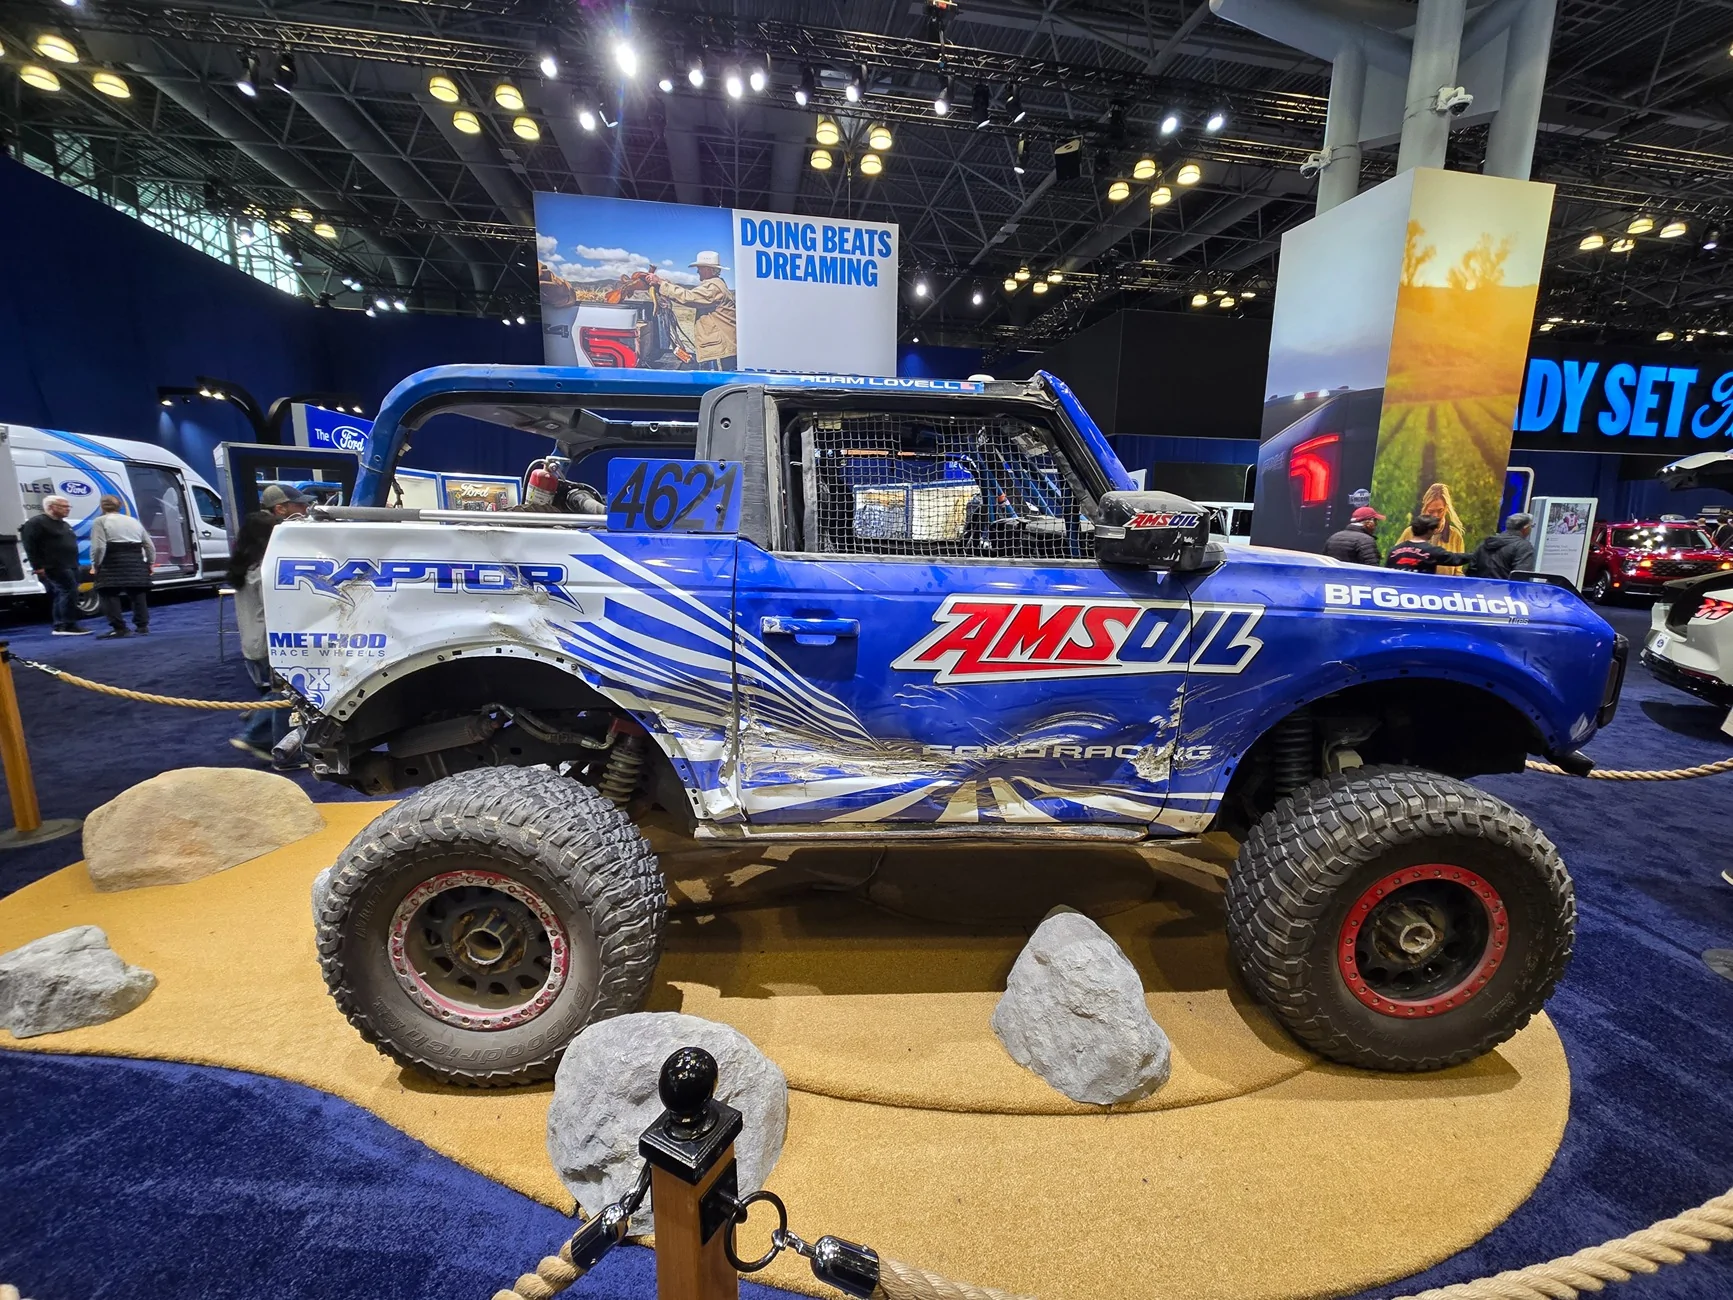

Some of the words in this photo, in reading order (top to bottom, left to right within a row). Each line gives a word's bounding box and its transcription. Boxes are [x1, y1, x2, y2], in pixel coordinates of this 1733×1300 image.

[740, 217, 817, 253] DOING
[822, 225, 892, 258] BEATS
[755, 250, 878, 287] DREAMING
[800, 374, 865, 385] ADAM
[868, 377, 959, 390] LOVELL
[1513, 358, 1600, 433] DY
[1597, 363, 1699, 438] SET
[314, 427, 330, 442] The
[340, 429, 365, 455] Ford
[65, 481, 89, 495] Ford
[460, 482, 490, 498] Ford
[609, 461, 738, 532] 4621
[1126, 512, 1201, 530] AMSOIL
[274, 557, 585, 614] RAPTOR
[1324, 583, 1530, 616] BFGoodrich
[1508, 616, 1530, 626] Tires
[269, 632, 388, 649] METHOD
[270, 649, 310, 658] RACE
[320, 649, 386, 658] WHEELS
[902, 598, 1258, 679] AMSOIL
[273, 666, 331, 703] FOX
